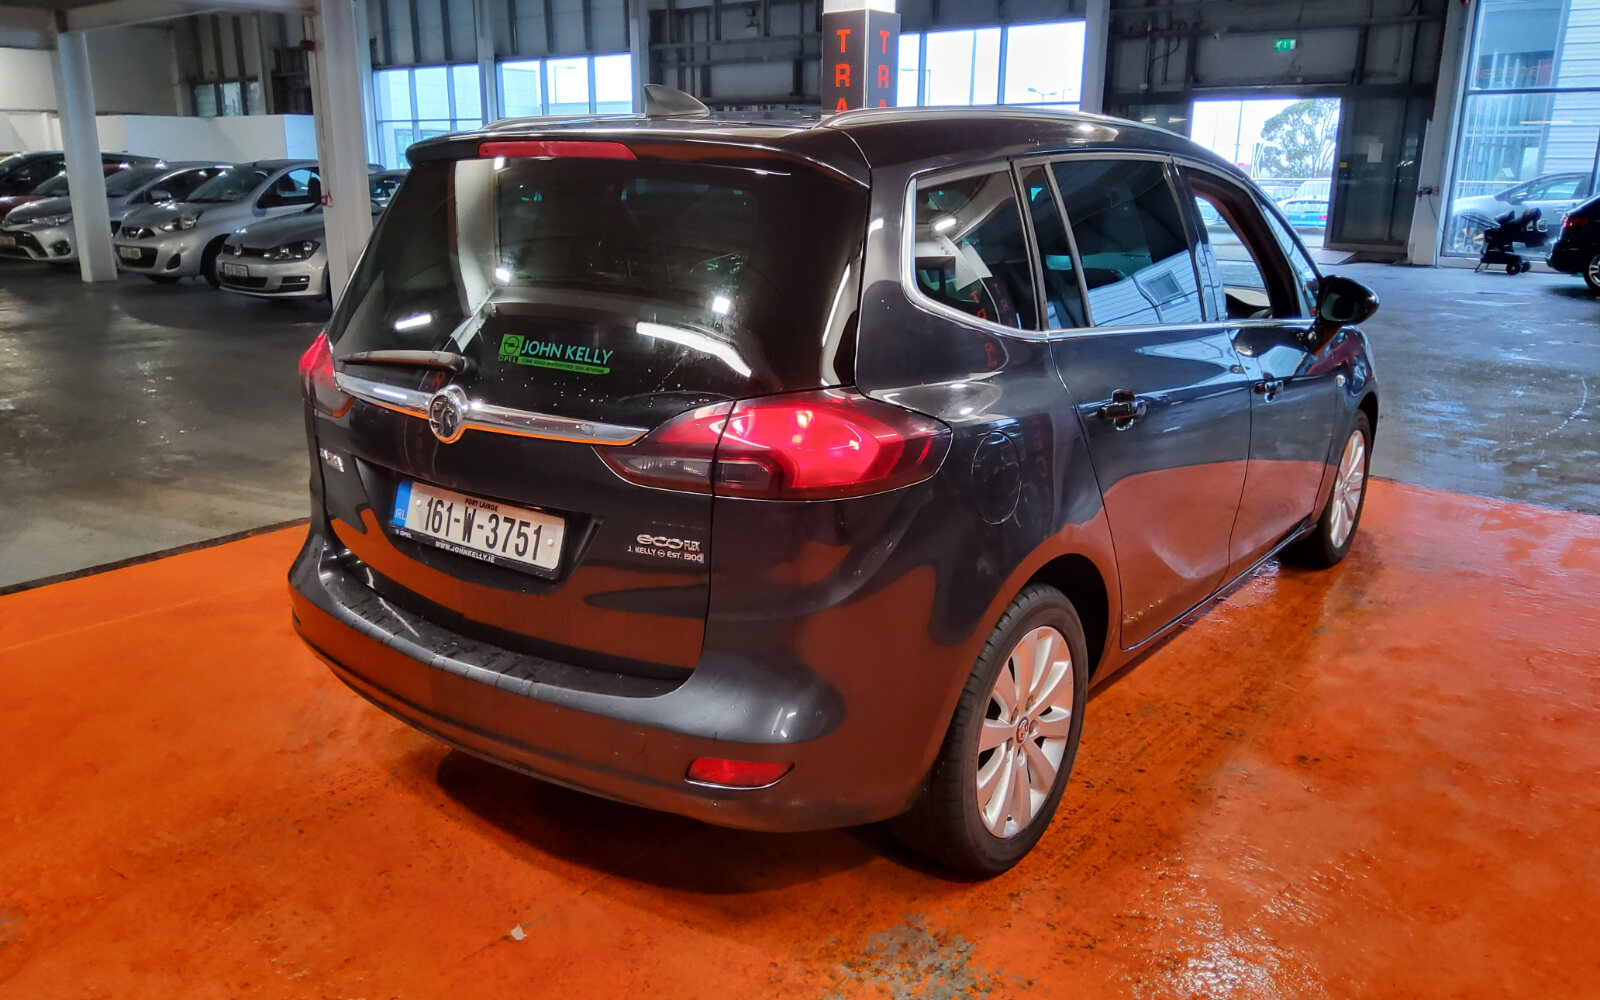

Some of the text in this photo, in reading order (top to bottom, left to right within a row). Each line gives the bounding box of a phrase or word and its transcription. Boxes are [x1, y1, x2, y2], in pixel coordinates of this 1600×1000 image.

[521, 339, 613, 364] JOHN KELLY
[465, 498, 479, 507] PORT
[394, 507, 406, 521] IRL
[424, 497, 543, 561] 161-W-3751
[435, 540, 496, 564] WWW.JOHNKELLY.IE
[635, 546, 657, 556] KELLY
[684, 552, 703, 562] 1900
